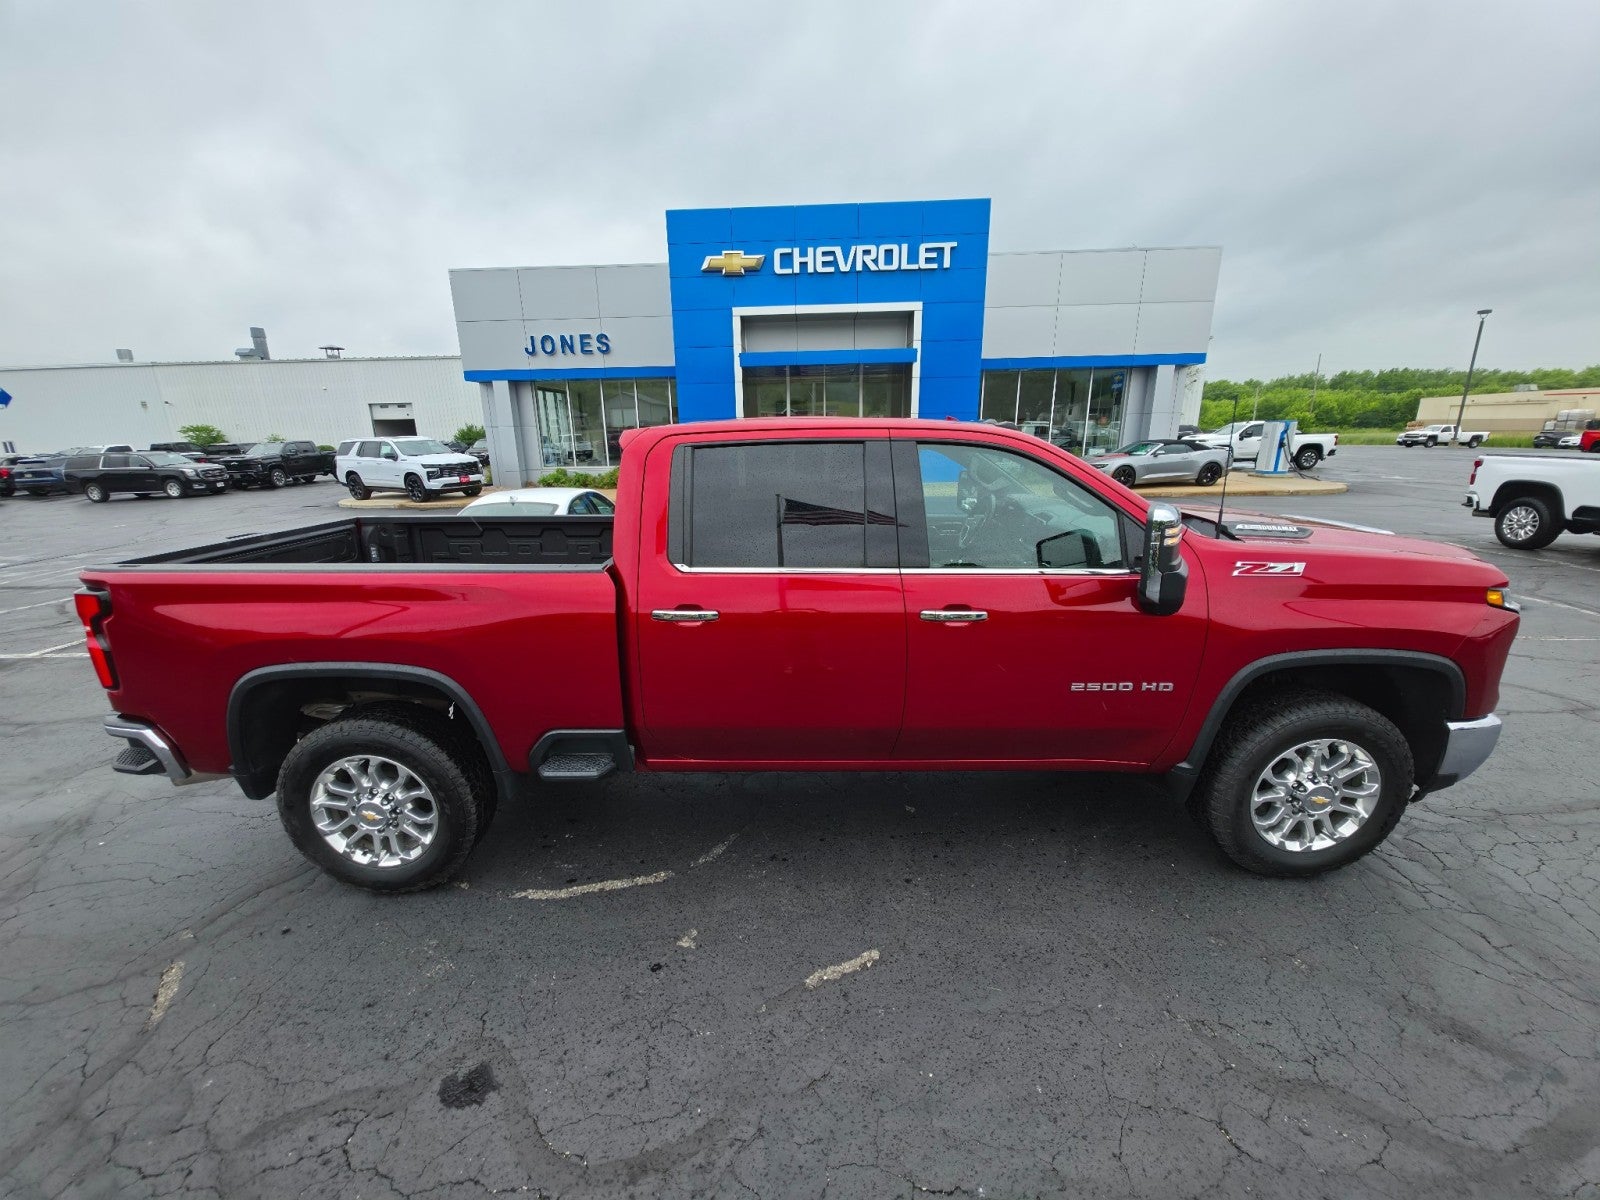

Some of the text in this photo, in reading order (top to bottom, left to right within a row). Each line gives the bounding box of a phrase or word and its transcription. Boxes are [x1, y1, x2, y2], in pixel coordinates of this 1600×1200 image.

[773, 241, 958, 275] CHEVROLET
[525, 333, 610, 356] JONES
[1232, 561, 1306, 577] Z71
[1070, 682, 1174, 692] 2500 HD
